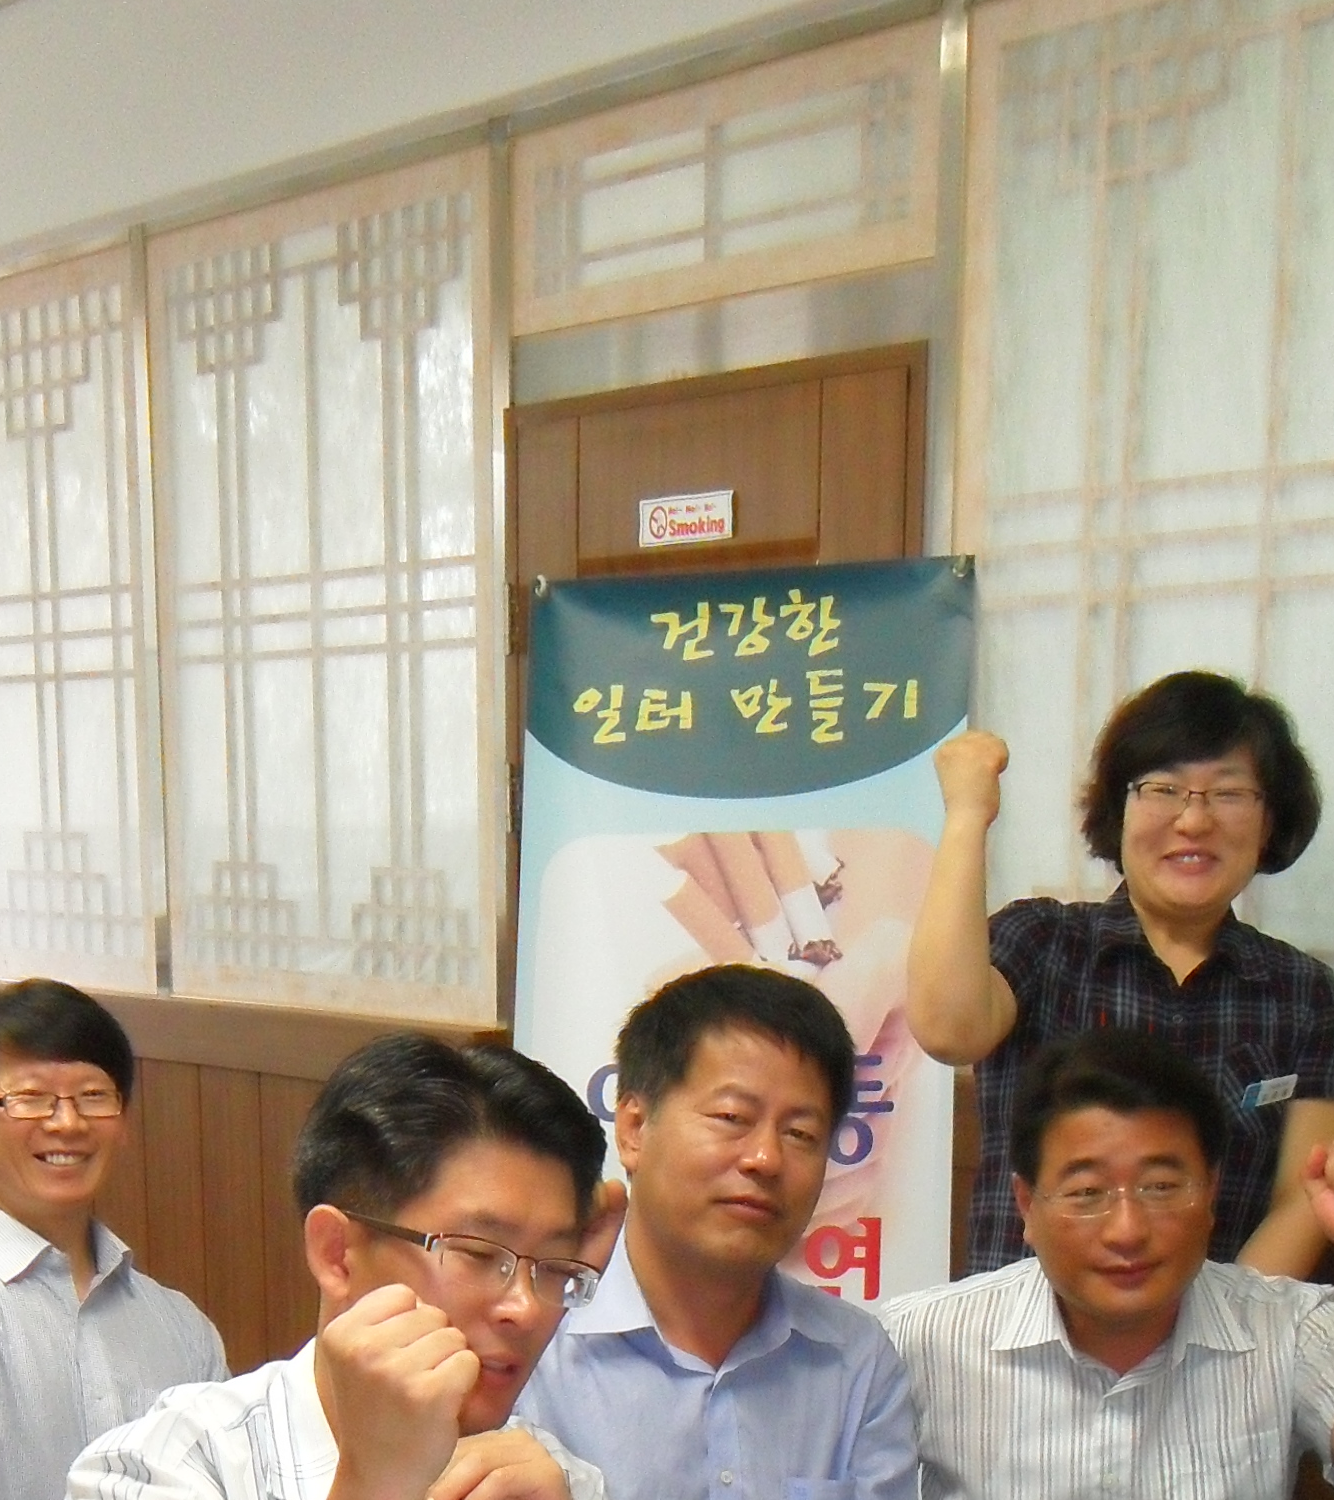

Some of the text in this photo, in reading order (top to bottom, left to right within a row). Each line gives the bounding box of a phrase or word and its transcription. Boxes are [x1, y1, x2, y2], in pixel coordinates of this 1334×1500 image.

[668, 515, 725, 537] Smoking
[650, 588, 842, 662] 건강한
[573, 669, 919, 744] 일터 만들기
